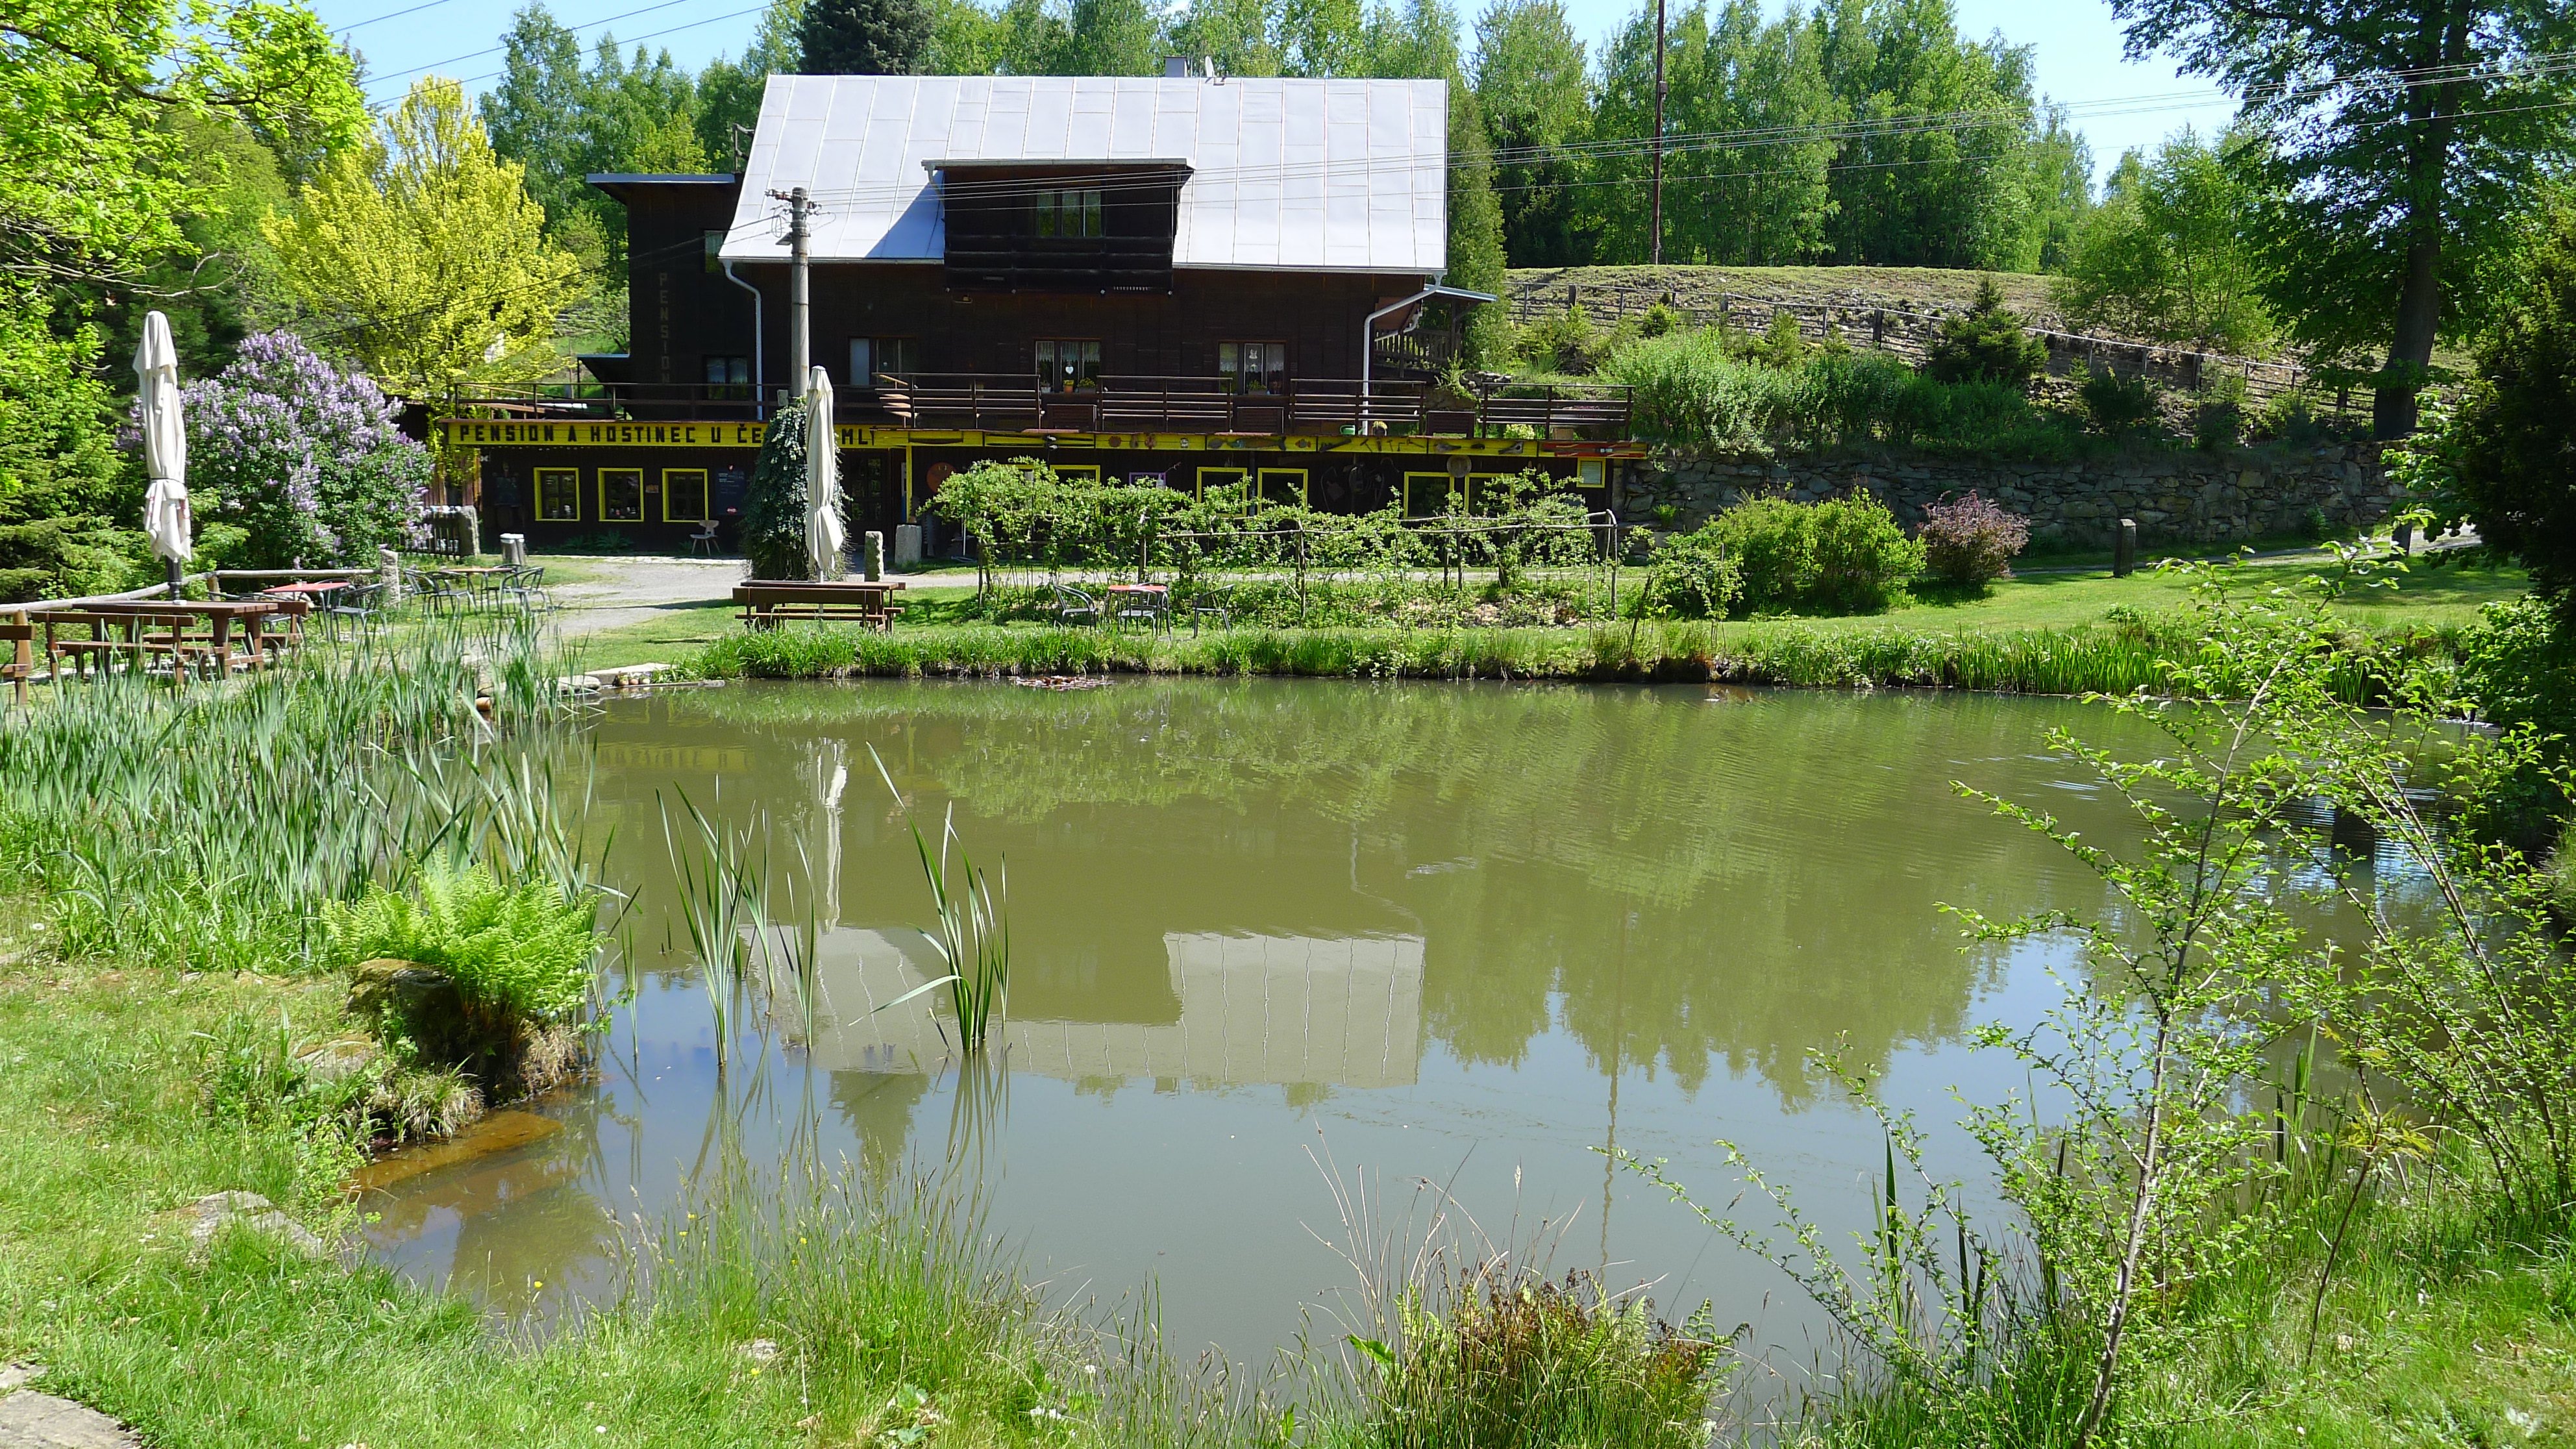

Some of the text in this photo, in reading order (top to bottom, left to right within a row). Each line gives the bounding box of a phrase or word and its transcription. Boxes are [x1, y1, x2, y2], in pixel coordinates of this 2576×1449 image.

[659, 271, 671, 383] PENSION
[460, 425, 554, 441] PENSION
[567, 426, 577, 441] A
[591, 426, 695, 443] HOSTINEC
[711, 427, 721, 443] U
